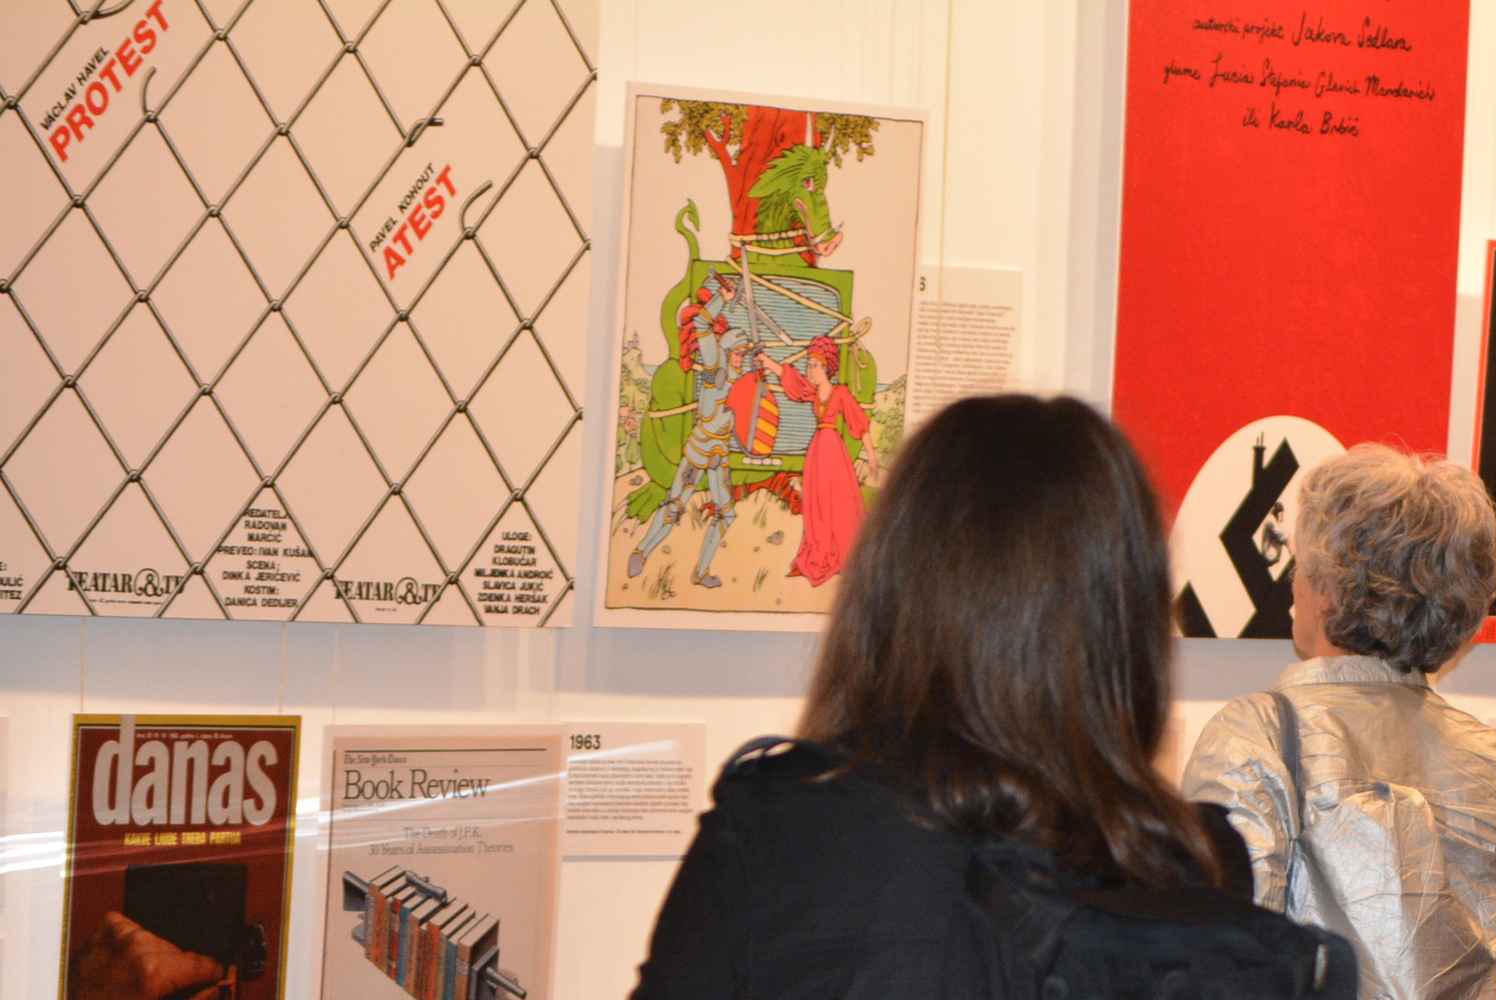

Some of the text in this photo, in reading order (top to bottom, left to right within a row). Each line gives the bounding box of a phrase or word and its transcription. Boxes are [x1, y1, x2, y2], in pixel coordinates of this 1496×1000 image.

[49, 0, 170, 162] PROTEST
[76, 46, 109, 86] HAVEL
[369, 163, 435, 252] PAVEL KOHOUT
[383, 164, 456, 281] ATEST
[244, 520, 287, 530] RADOVAN
[92, 714, 279, 826] danas
[569, 734, 602, 750] 1963
[343, 767, 491, 801] Book Review
